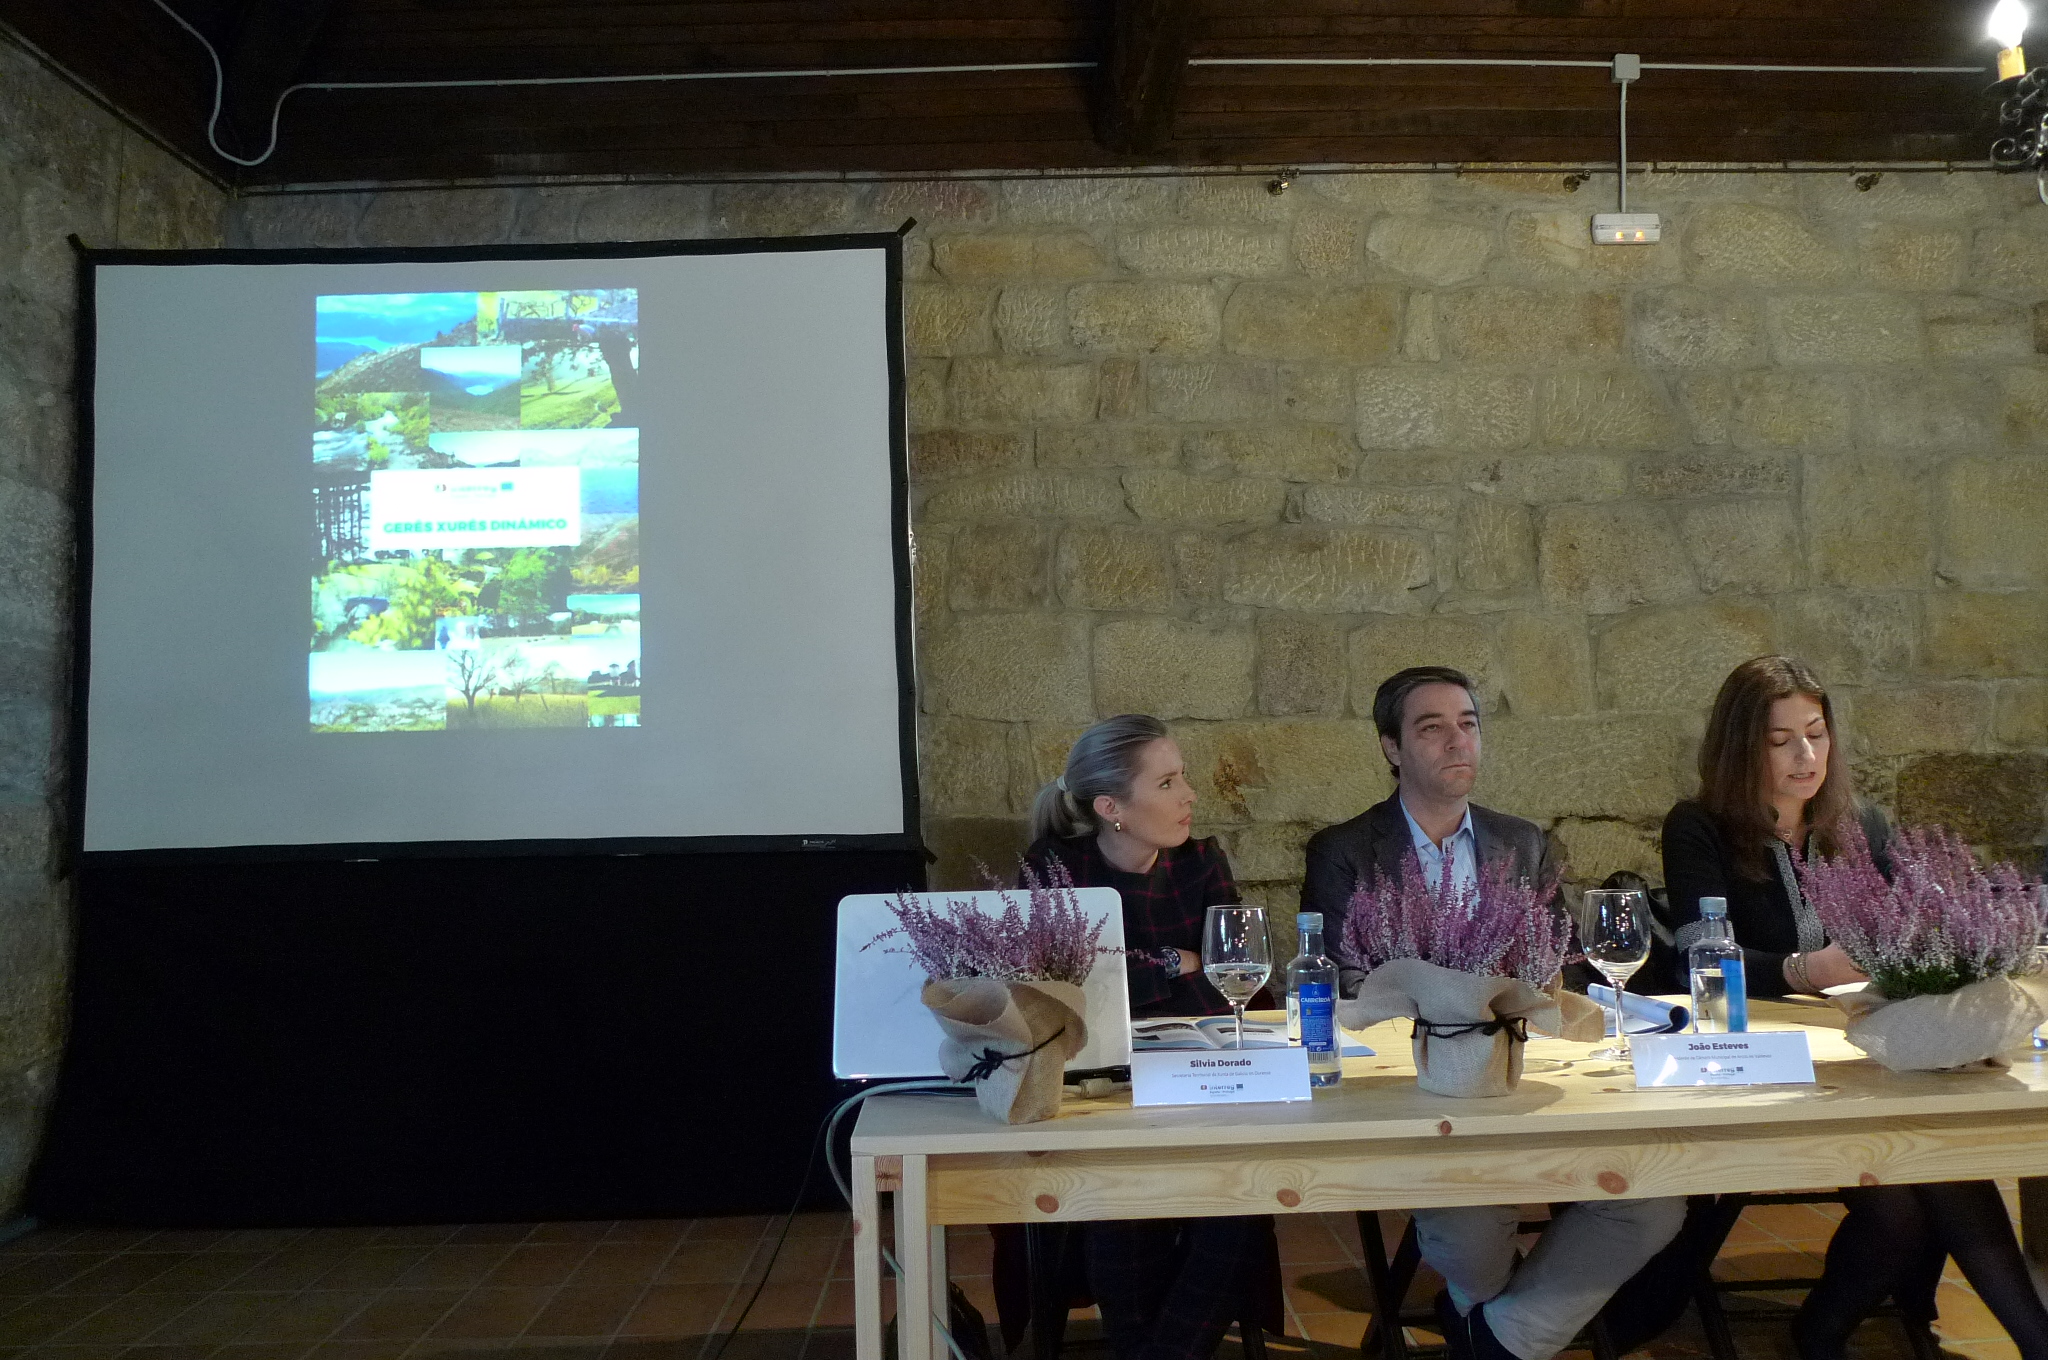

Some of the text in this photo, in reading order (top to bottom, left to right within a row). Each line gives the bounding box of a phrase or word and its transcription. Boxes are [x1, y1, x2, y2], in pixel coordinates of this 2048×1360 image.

[383, 517, 567, 533] GERÉS XURÉS DINÁMICO
[1688, 1042, 1749, 1051] João Esteves
[1190, 1058, 1252, 1068] Silvia Dorado
